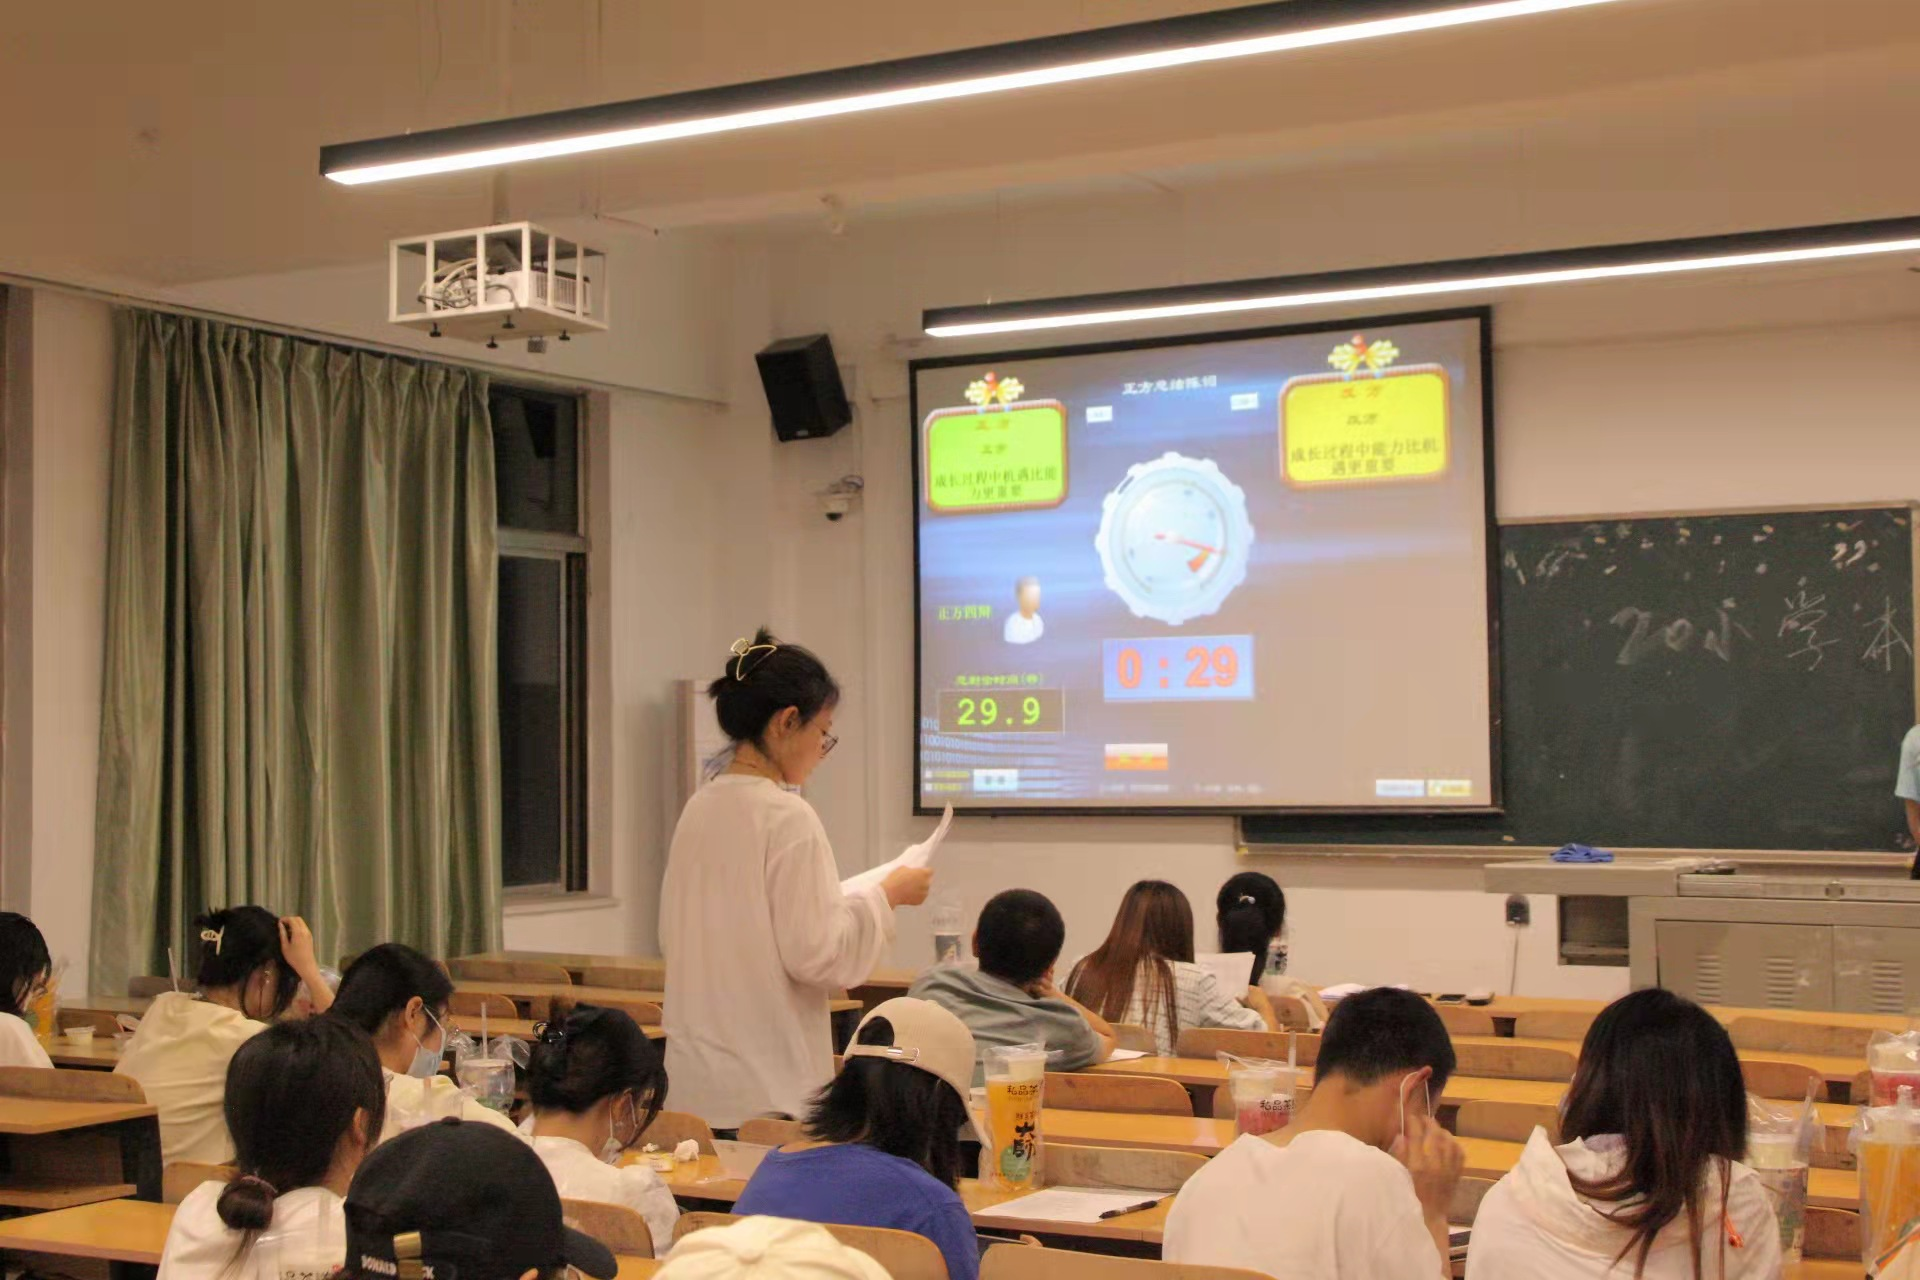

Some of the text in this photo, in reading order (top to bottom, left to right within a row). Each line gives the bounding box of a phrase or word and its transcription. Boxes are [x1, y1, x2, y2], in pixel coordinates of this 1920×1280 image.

[1291, 437, 1440, 463] 成长过程中能力比机
[934, 465, 1058, 488] 成长过程中机遇比能
[1331, 457, 1396, 477] 遇更重要
[957, 696, 1041, 726] 29.9
